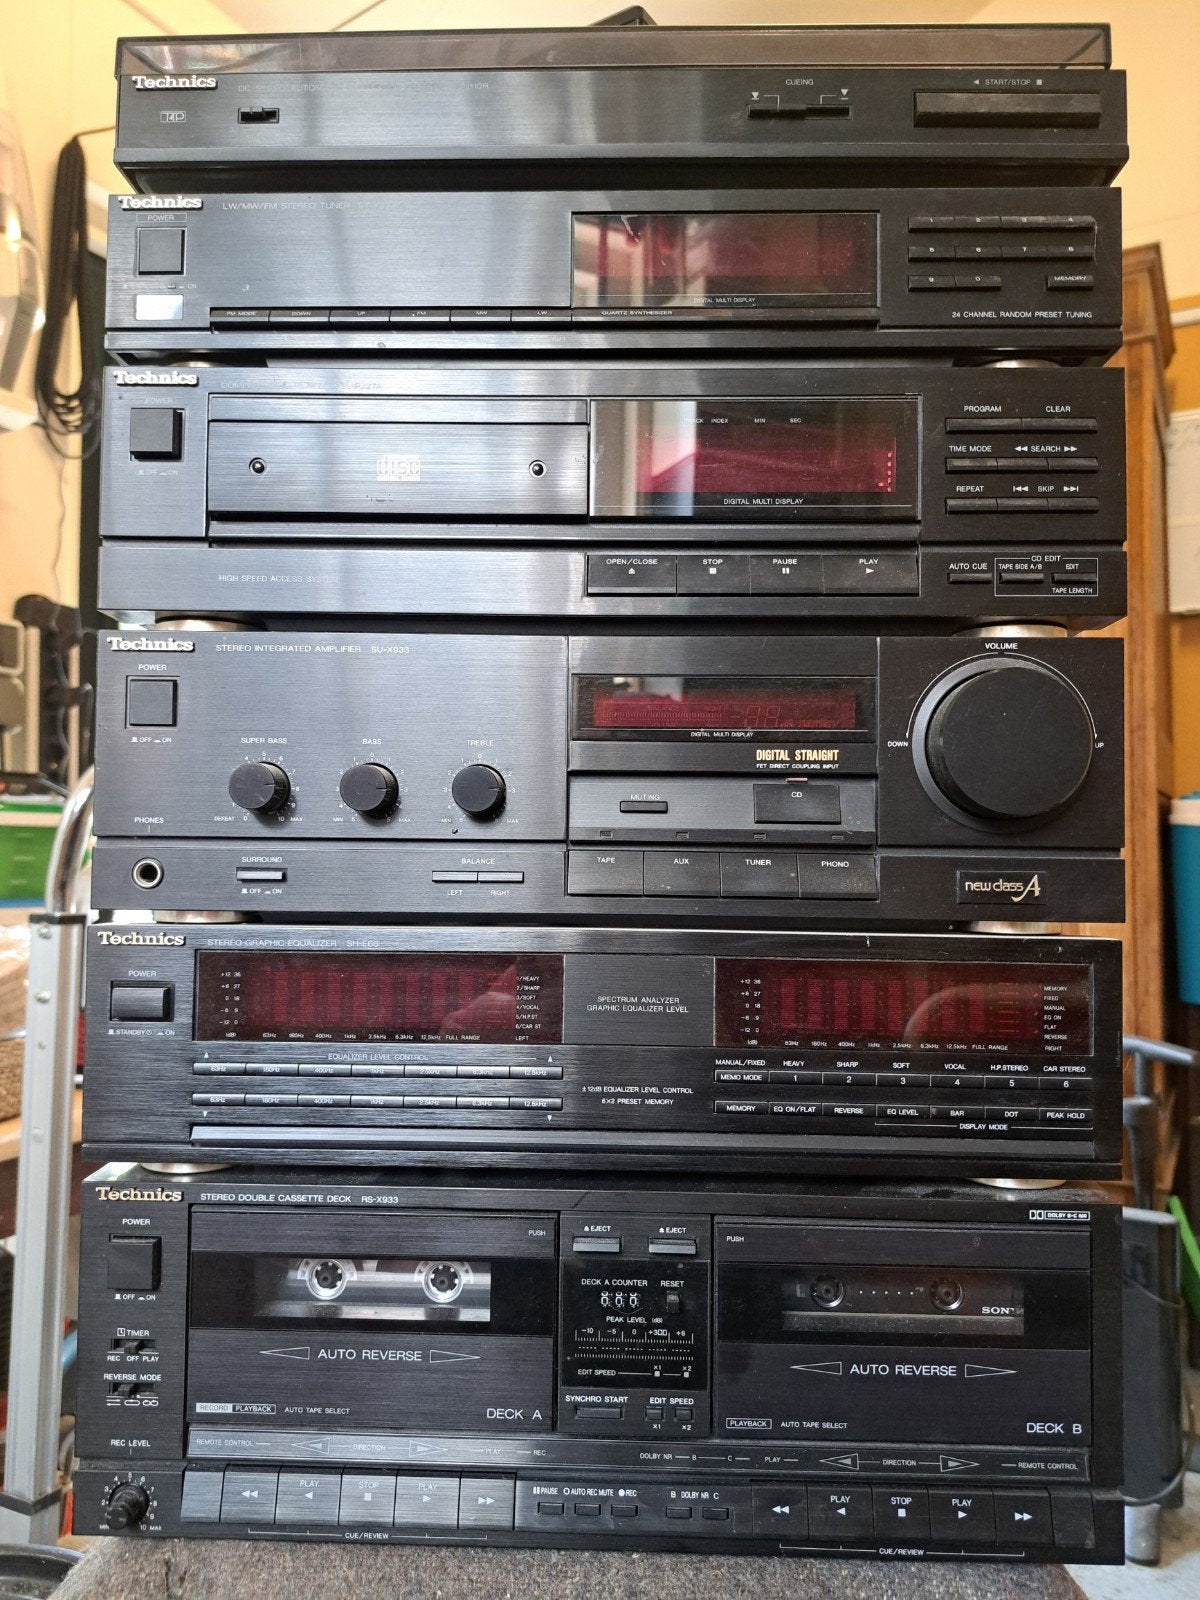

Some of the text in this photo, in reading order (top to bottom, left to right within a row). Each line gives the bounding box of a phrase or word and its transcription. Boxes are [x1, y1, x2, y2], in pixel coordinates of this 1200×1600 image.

[132, 75, 217, 89] Technics
[785, 78, 814, 86] CUEING
[984, 78, 1031, 86] START/STOP
[118, 196, 202, 209] Technics
[222, 202, 277, 210] LW/MW/FM
[281, 202, 316, 210] STEREO
[320, 202, 350, 210] TUNER
[1066, 311, 1093, 319] TUNING
[113, 371, 198, 385] Technics
[963, 405, 1002, 413] PROGRAM
[1045, 405, 1071, 413] CLEAR
[1030, 445, 1061, 453] SEARCH
[270, 575, 302, 583] ACCESS
[107, 637, 194, 651] Technics
[985, 642, 1018, 650] VOLUME
[216, 644, 410, 654] STEREO INTEGRATED AMPLIFIER SU-X933
[756, 749, 840, 762] DIGITAL STRAIGHT
[965, 874, 1042, 903] new class A
[98, 931, 185, 946] Technics
[207, 939, 337, 948] STEREO GRAPHIC EQUALIZER
[640, 996, 680, 1004] ANALYZER
[586, 1004, 621, 1012] GRAPHIC
[622, 1005, 664, 1013] EQUALIZER
[988, 1123, 1008, 1131] MODE
[96, 1187, 182, 1202] Technics
[200, 1193, 399, 1204] STEREO DOUBLE CASSETTE DECK RS-X933
[581, 1278, 602, 1286] DECK
[126, 1329, 150, 1337] TIMER
[317, 1349, 423, 1362] AUTO REVERSE
[850, 1363, 957, 1377] AUTO REVERSE
[103, 1373, 137, 1381] REVERSE
[565, 1394, 629, 1403] SYNCHRO START
[199, 1404, 229, 1412] RECORD
[235, 1405, 272, 1413] PLAYBACK
[486, 1408, 543, 1420] DECK A
[729, 1420, 767, 1428] PLAYBACK
[1026, 1422, 1082, 1434] DECK B
[541, 1487, 559, 1495] PAUSE
[878, 1547, 925, 1556] CUE/REVIEW
